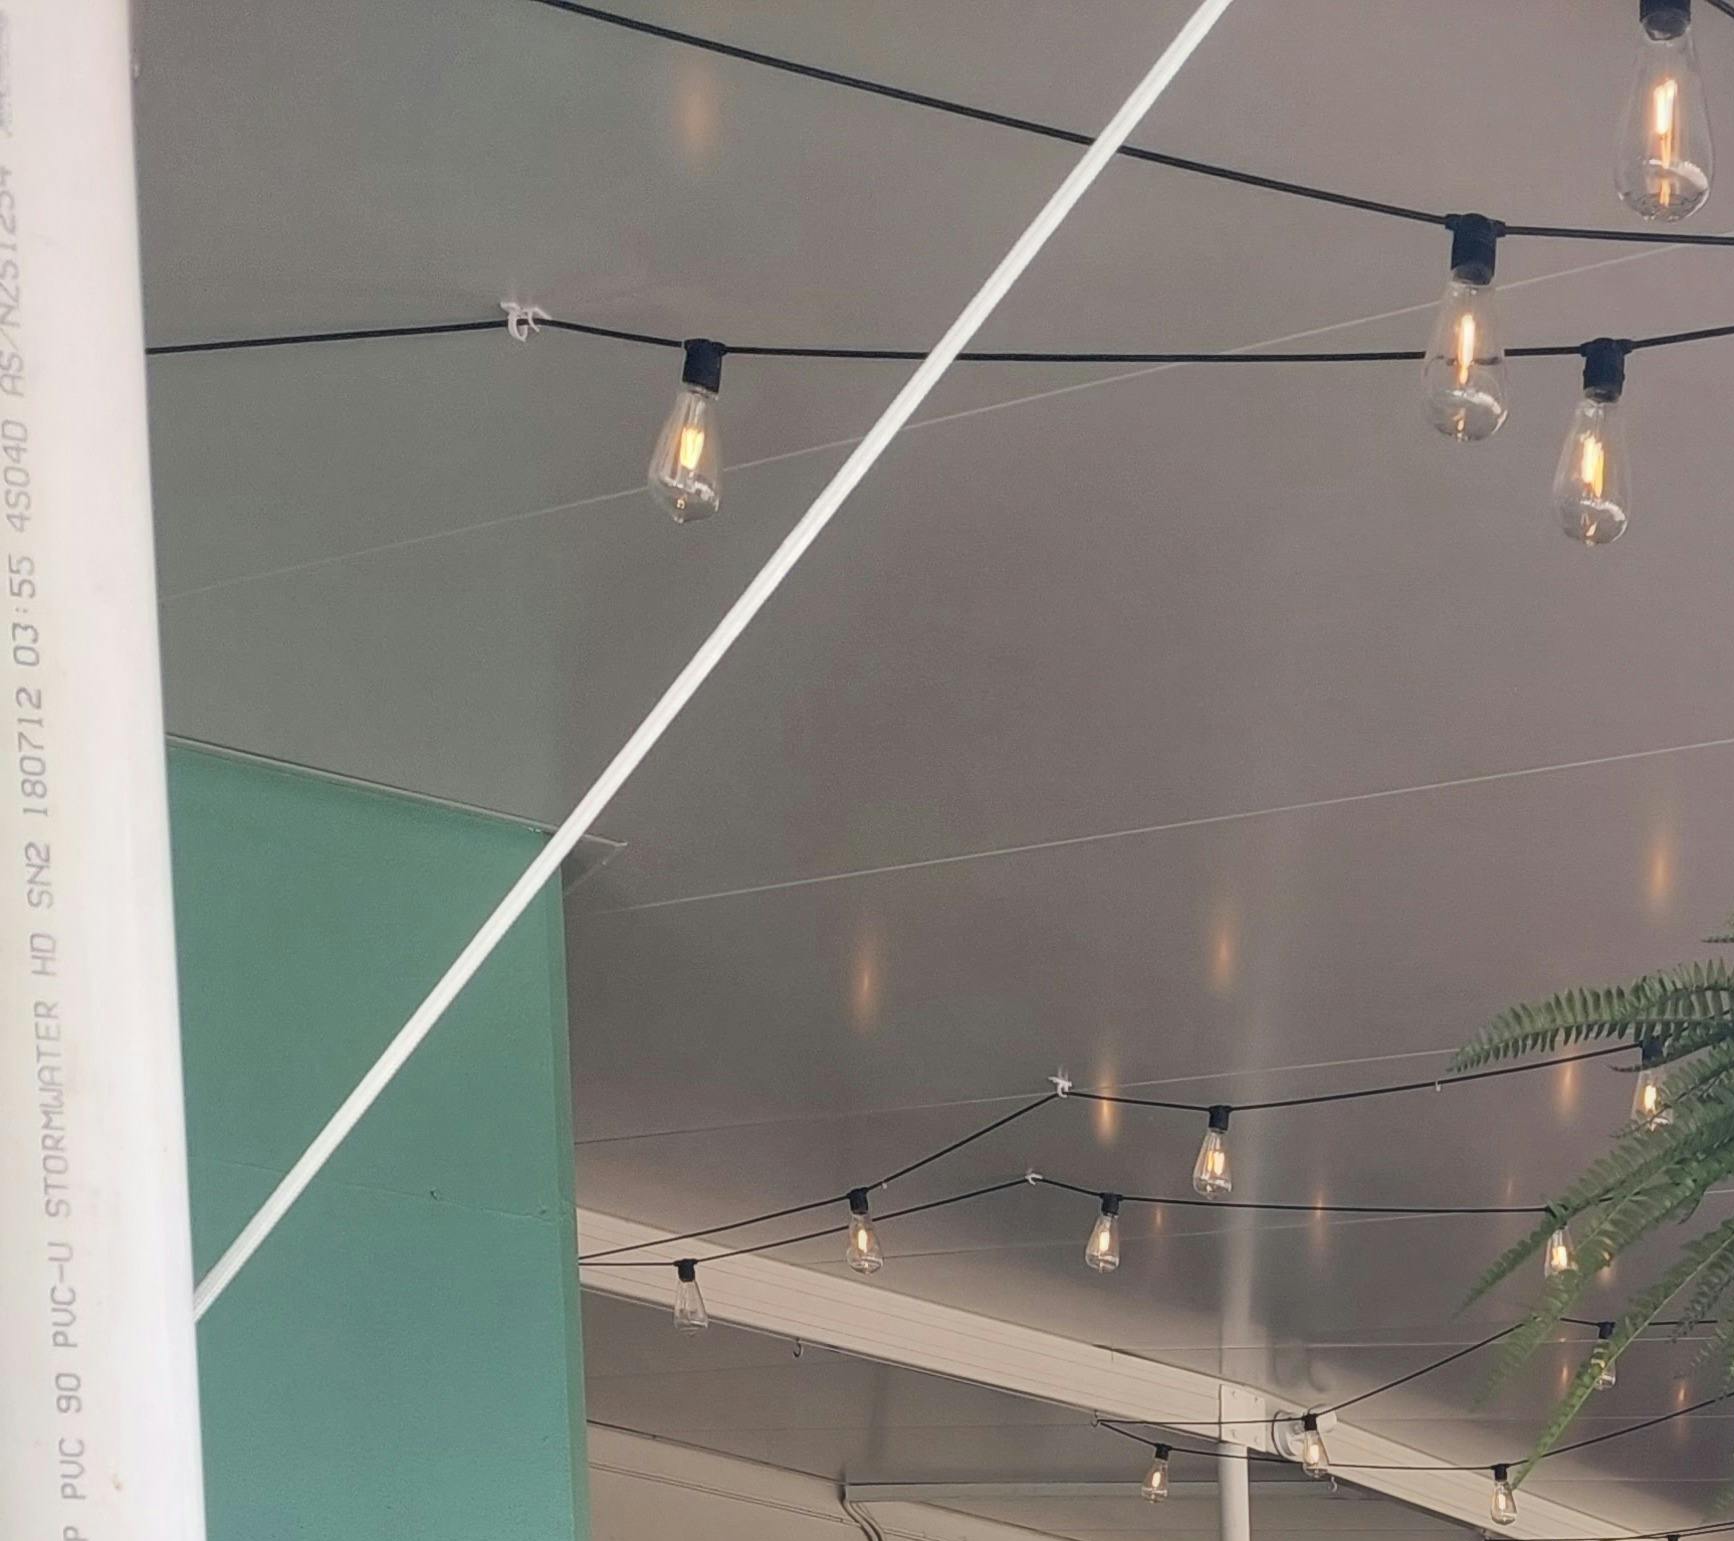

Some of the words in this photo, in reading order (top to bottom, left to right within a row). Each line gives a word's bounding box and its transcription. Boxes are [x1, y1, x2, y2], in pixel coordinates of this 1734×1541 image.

[15, 686, 48, 818] 180712
[25, 840, 54, 908] SN2
[29, 932, 58, 975] HD
[34, 1000, 72, 1217] STORMWATER
[47, 1240, 77, 1348] PVC-U
[55, 1371, 83, 1413] 90
[58, 1437, 87, 1499] PVC
